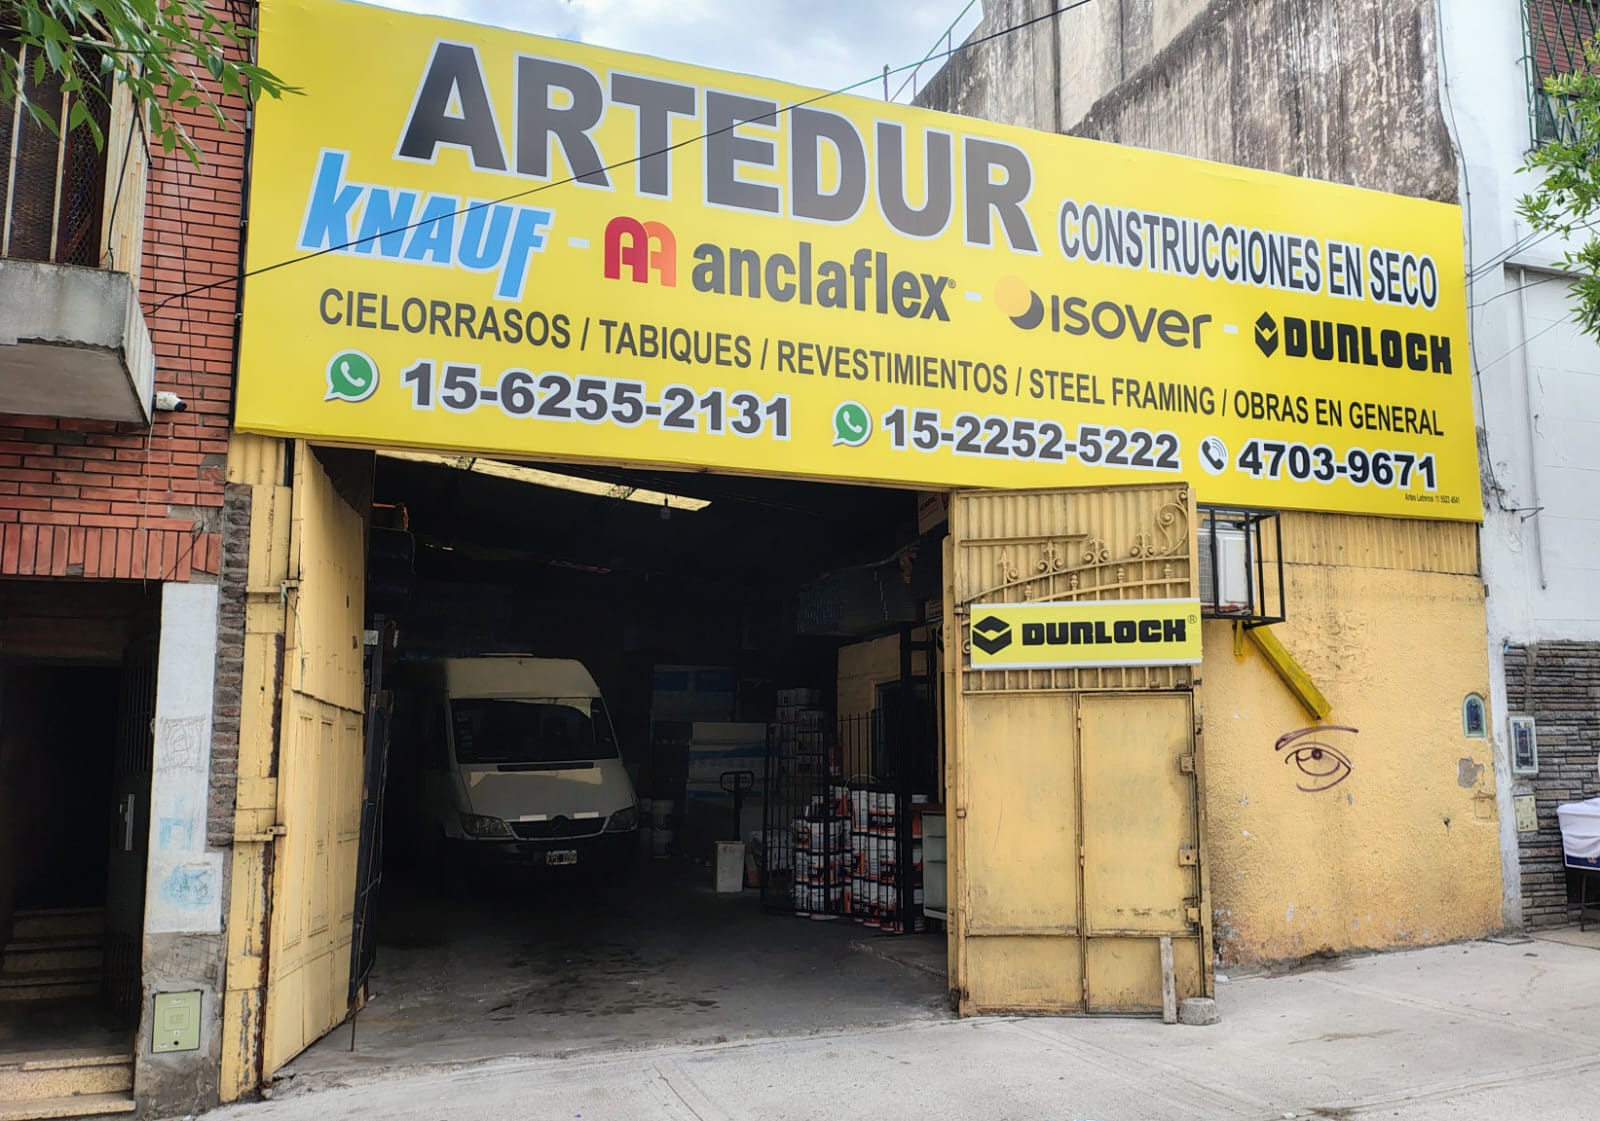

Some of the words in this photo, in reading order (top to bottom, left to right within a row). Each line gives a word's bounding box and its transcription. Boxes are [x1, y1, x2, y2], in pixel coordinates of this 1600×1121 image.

[396, 40, 1040, 255] ARTEDUR
[295, 148, 556, 301] KNAUF
[1283, 316, 1453, 375] DURLOCK
[1060, 200, 1321, 294] CONSTRUCCIONES
[1327, 242, 1364, 298] EN
[1367, 248, 1438, 309] SECO
[320, 288, 571, 349] CIELORRASOS
[599, 319, 752, 369] TABIQUES
[777, 340, 1008, 395] REVESTIMIENTOS
[1029, 368, 1106, 405] STEEL
[1112, 377, 1215, 416] FRAMING
[1234, 390, 1309, 424] OBRAS
[1315, 398, 1343, 428] EN
[1348, 401, 1445, 437] GENERAL
[403, 361, 788, 438] 15-6255-2131
[884, 407, 1180, 470] 15-2252-5222
[1237, 440, 1436, 490] 4703-9671
